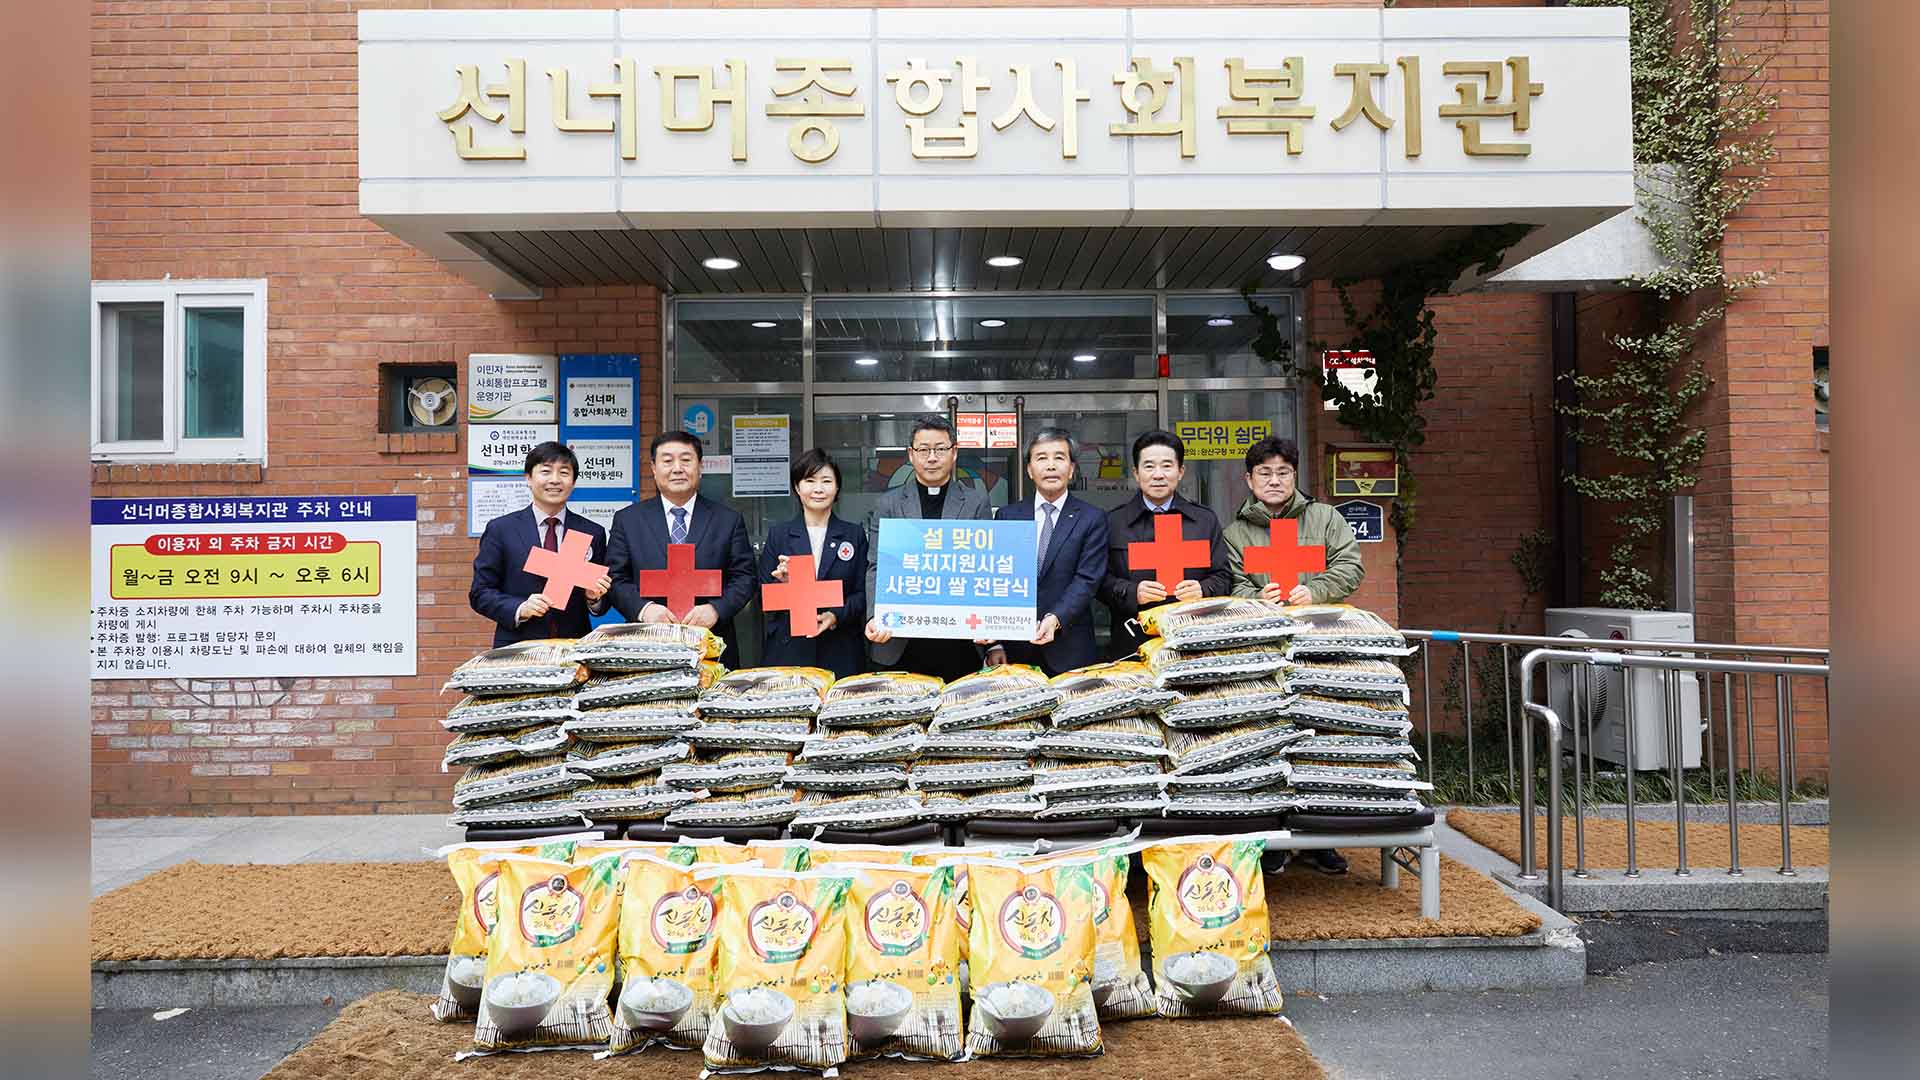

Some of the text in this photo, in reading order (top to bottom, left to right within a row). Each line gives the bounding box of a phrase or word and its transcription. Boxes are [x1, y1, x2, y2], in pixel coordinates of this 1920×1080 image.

[436, 55, 1545, 165] 선너머종합사회복지관
[476, 365, 504, 375] 이민자
[476, 378, 548, 389] 사회통합프로그램
[476, 392, 512, 402] 운영기관
[584, 394, 616, 407] 선너머
[572, 407, 628, 418] 종합사회복지관
[1181, 426, 1267, 445] 무더위 쉼터
[584, 457, 616, 470] 선너머
[121, 500, 372, 520] 선너머종합사회복지관 주차 안내
[158, 535, 334, 552] 이용자 외 주차 금지 시간
[922, 527, 994, 551] 설 맞이
[902, 552, 1014, 575] 복지지원시설
[122, 568, 175, 587] 월~금
[184, 568, 220, 586] 오전
[230, 568, 258, 585] 9시
[296, 566, 332, 584] 오후
[342, 566, 369, 584] 6시
[886, 575, 1029, 598] 사랑의 쌀 전달식
[97, 602, 382, 617] 주차증 소지차량에 한해 주차 가능하며 주차시 주차증을
[97, 619, 157, 630] 차량에 게시
[898, 615, 1032, 626] 전주상공회의소 대한적십자사
[97, 632, 129, 644] 주차증
[166, 632, 210, 643] 프로그램
[216, 632, 248, 642] 담당자
[254, 631, 276, 642] 문의
[97, 642, 404, 657] 본 주차장 이용시 차량도난 및 파손에 대하여 일체의 책임을
[96, 658, 171, 670] 지지 않습니다.
